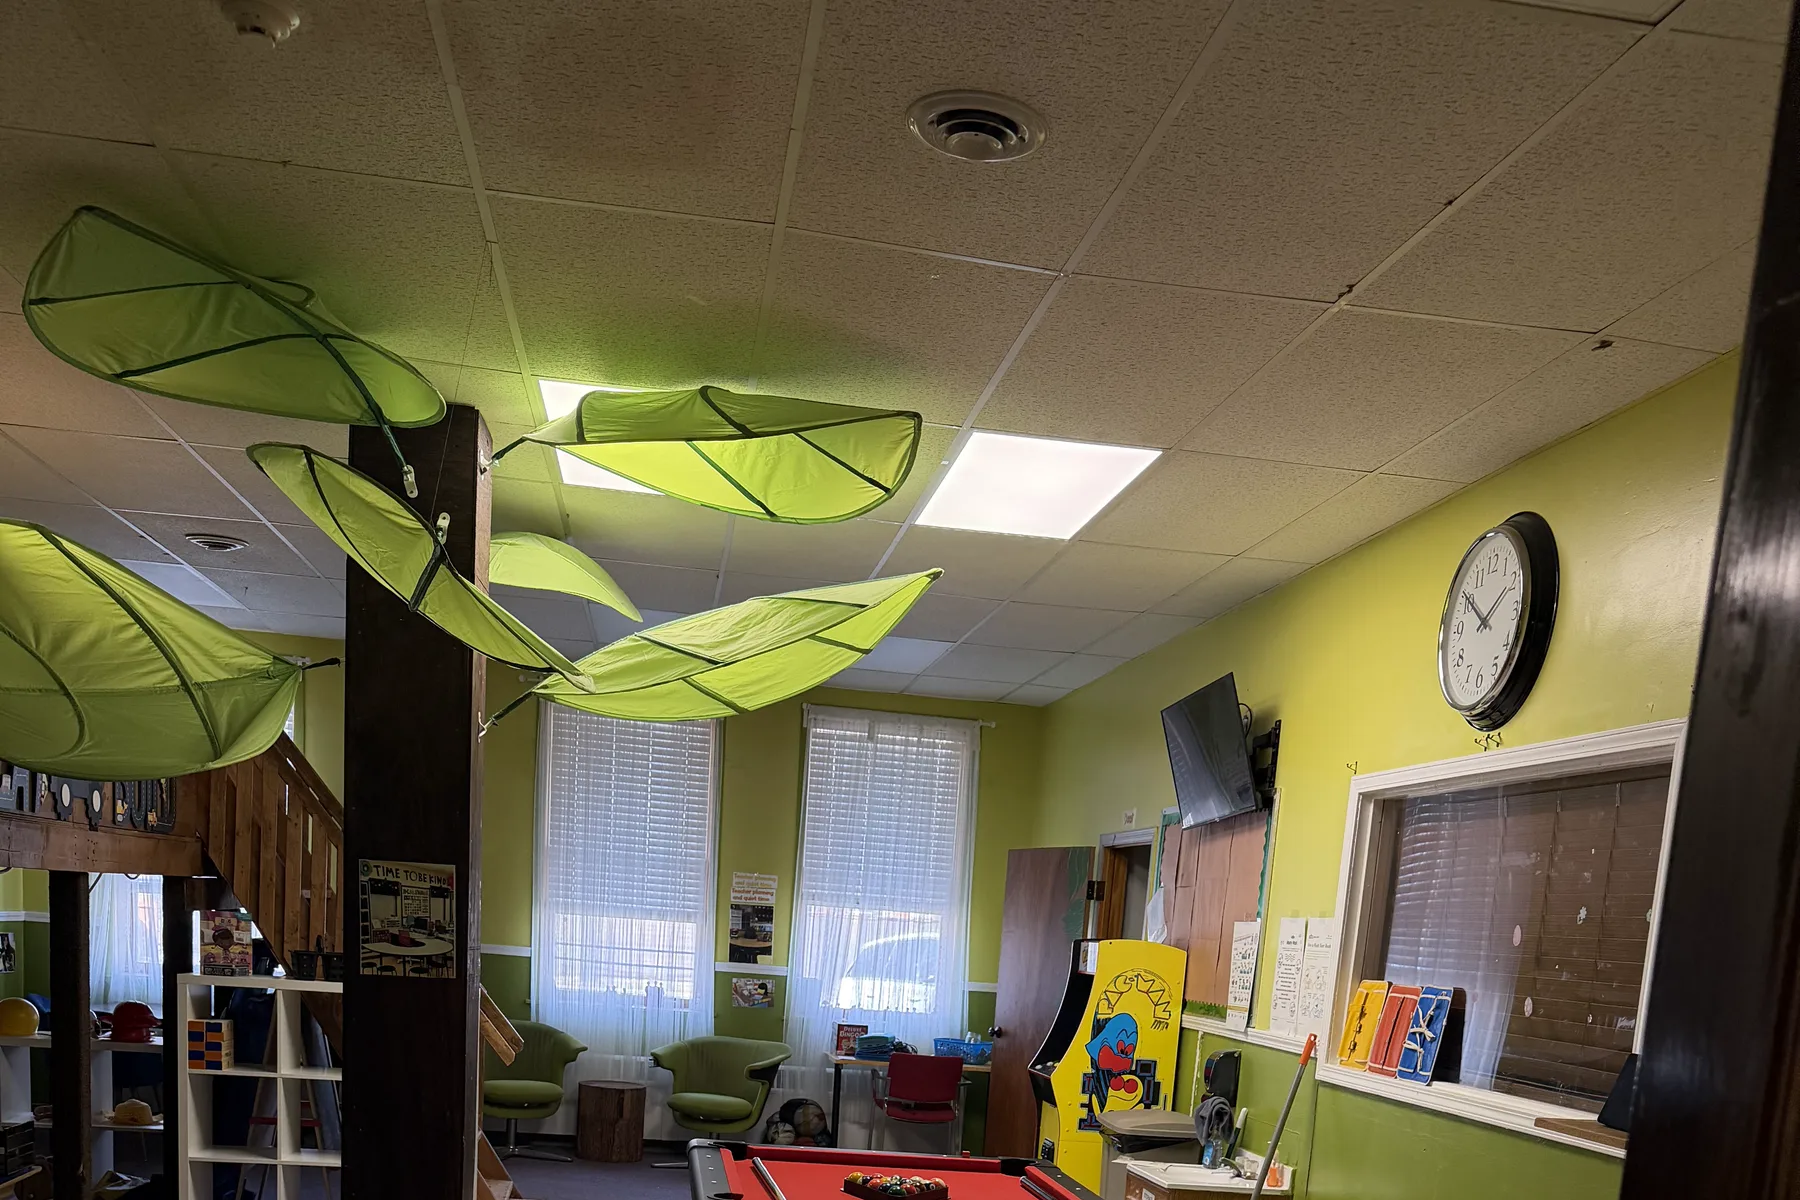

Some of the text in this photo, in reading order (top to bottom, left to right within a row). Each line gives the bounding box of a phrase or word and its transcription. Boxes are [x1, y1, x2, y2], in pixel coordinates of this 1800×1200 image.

[1486, 553, 1499, 575] 12
[1502, 556, 1508, 577] 1
[1474, 568, 1485, 589] 11
[1508, 571, 1517, 591] 2
[1463, 594, 1475, 615] 10
[1510, 600, 1519, 621] 3
[1456, 620, 1464, 642] 9
[1502, 630, 1510, 652] 4
[1456, 648, 1465, 668] 8
[1491, 655, 1500, 677] 5
[1465, 664, 1473, 684] 7
[1475, 666, 1484, 688] 6
[373, 865, 401, 879] TIME
